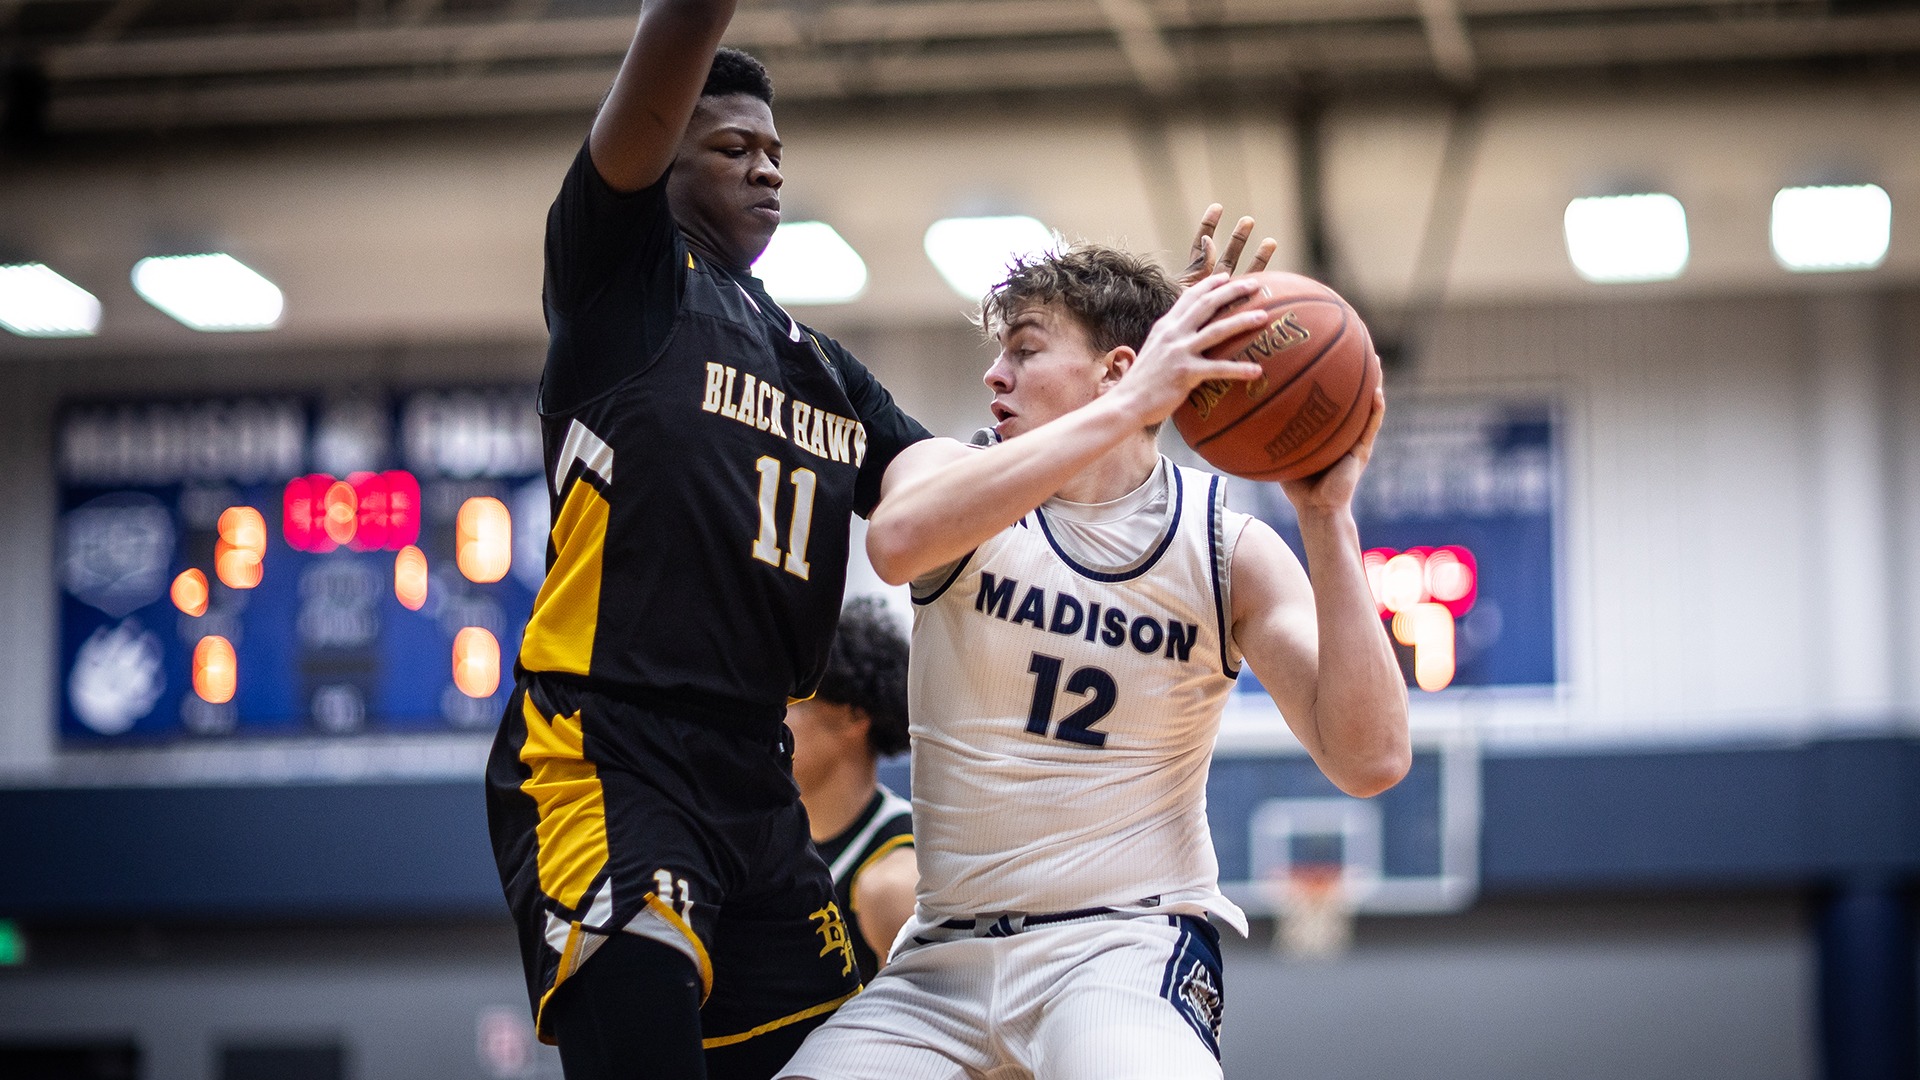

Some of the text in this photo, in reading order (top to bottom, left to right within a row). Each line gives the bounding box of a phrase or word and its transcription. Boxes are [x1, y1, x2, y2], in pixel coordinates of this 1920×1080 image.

[702, 361, 787, 439] BLACK
[1187, 311, 1311, 420] SPALING
[752, 455, 816, 581] 11
[974, 570, 1199, 663] MADISON
[1023, 650, 1119, 748] 12
